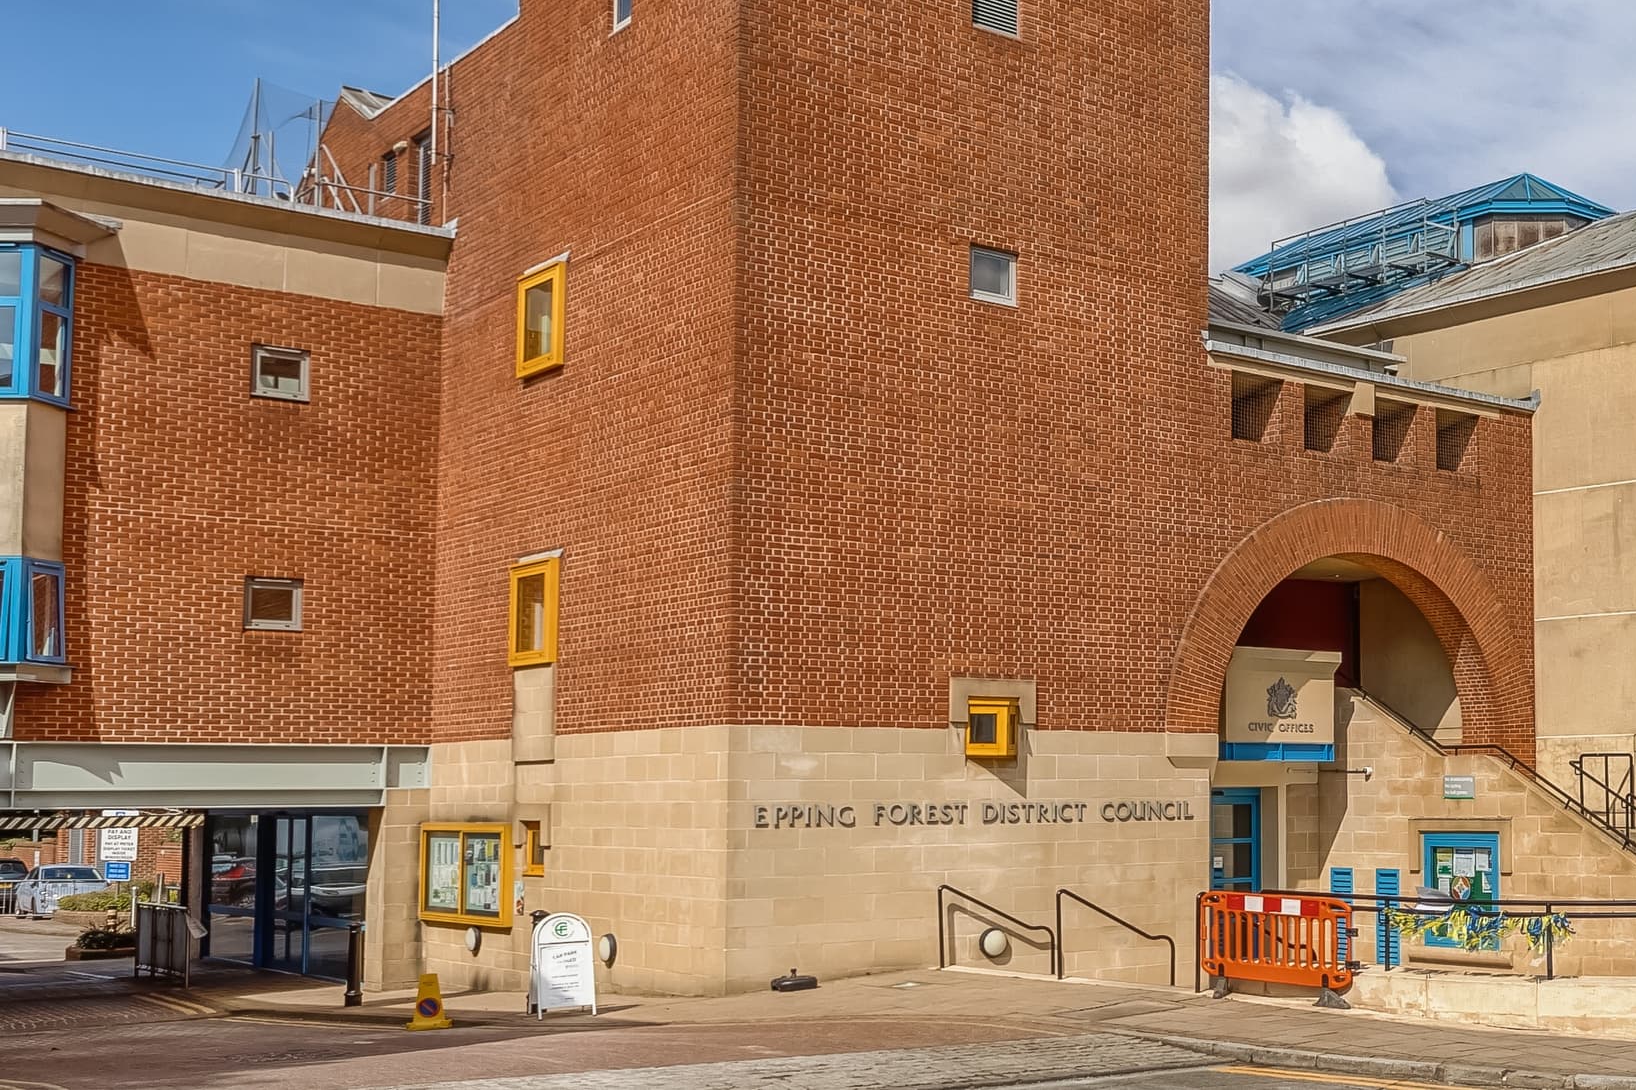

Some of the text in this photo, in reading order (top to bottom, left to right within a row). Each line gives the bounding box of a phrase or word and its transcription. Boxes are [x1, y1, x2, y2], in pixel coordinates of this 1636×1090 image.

[1248, 722, 1314, 733] CIVIC OFFICES
[755, 800, 1194, 829] EPPING FOREST DISTRICT COUNCIL
